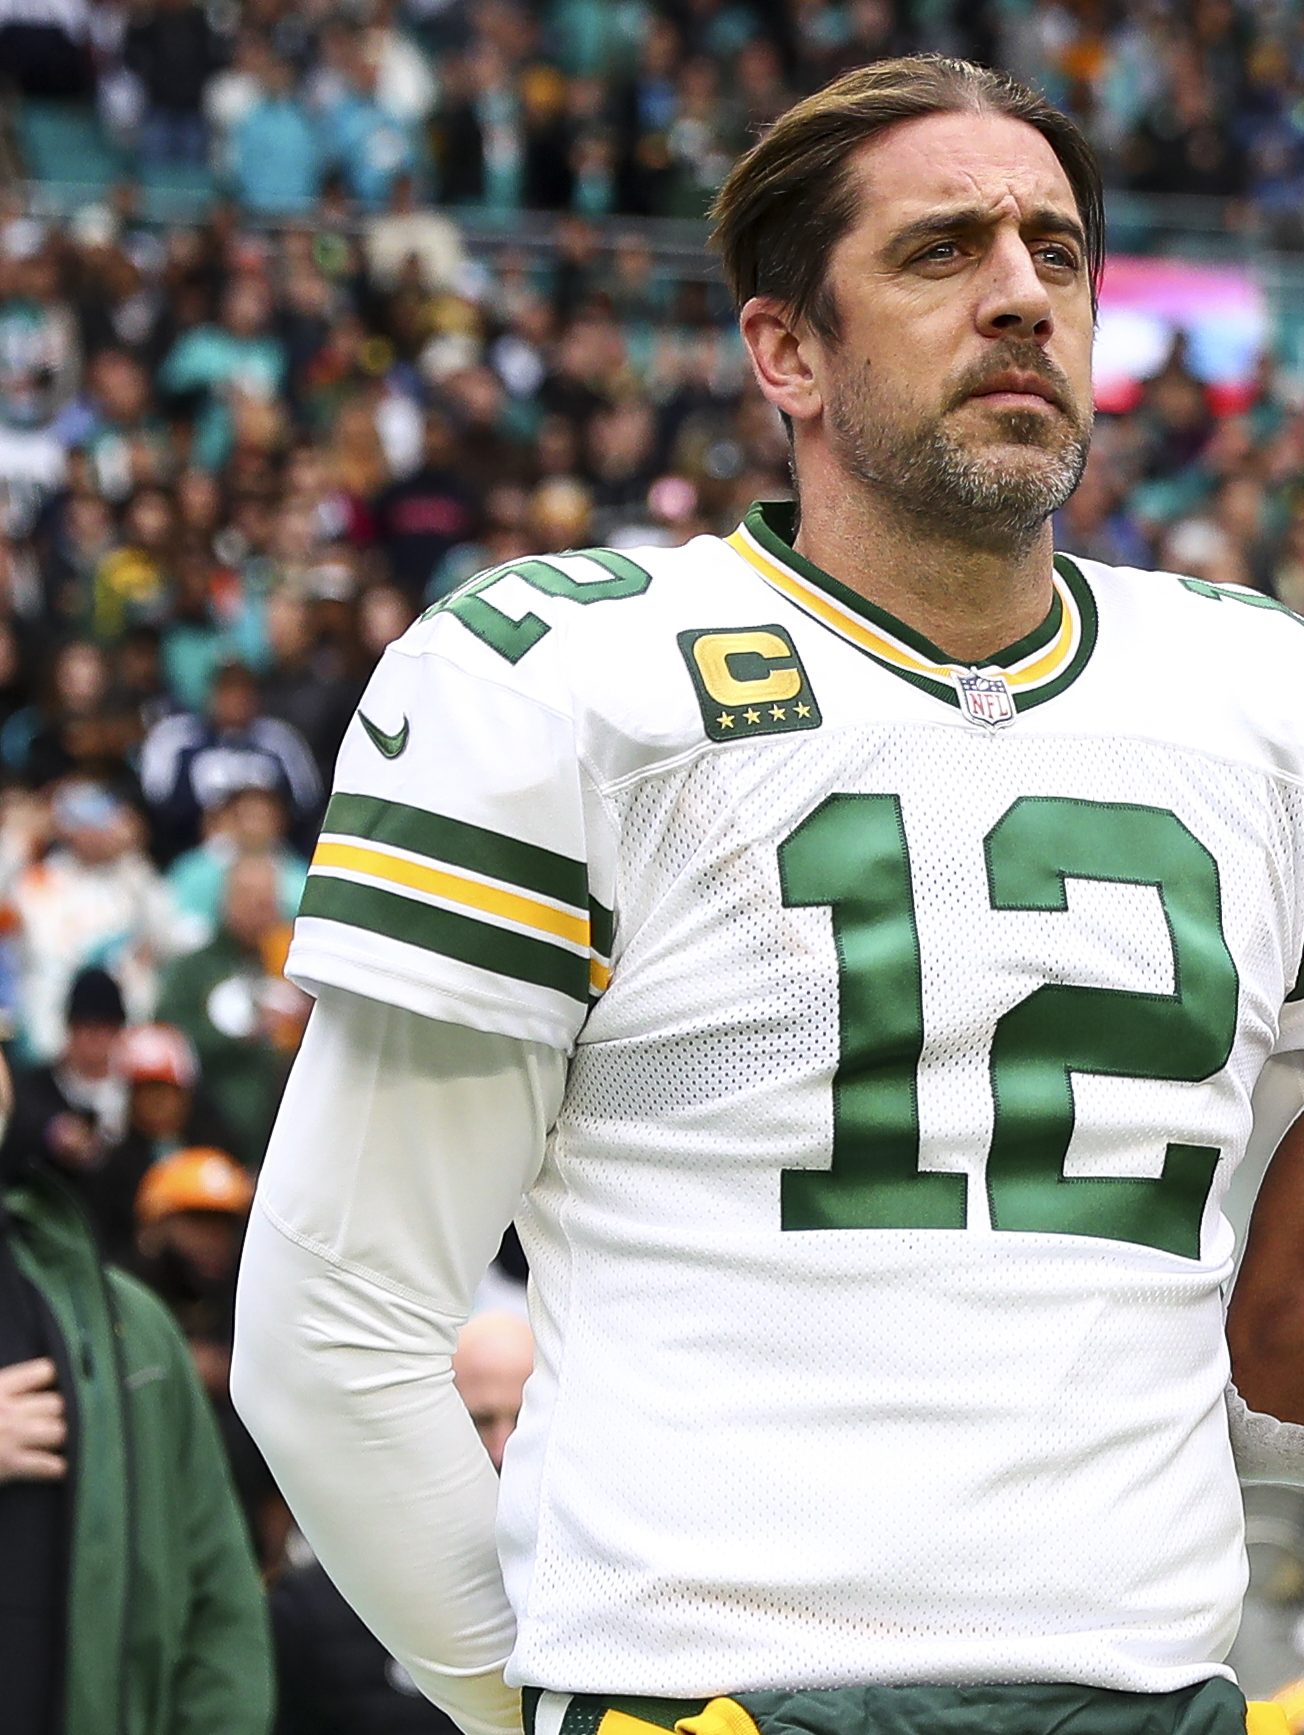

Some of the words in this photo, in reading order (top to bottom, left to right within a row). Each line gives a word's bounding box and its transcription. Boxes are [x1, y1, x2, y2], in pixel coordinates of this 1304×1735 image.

[692, 630, 802, 707] C
[968, 692, 1009, 720] NFL
[777, 792, 1239, 1261] 12
